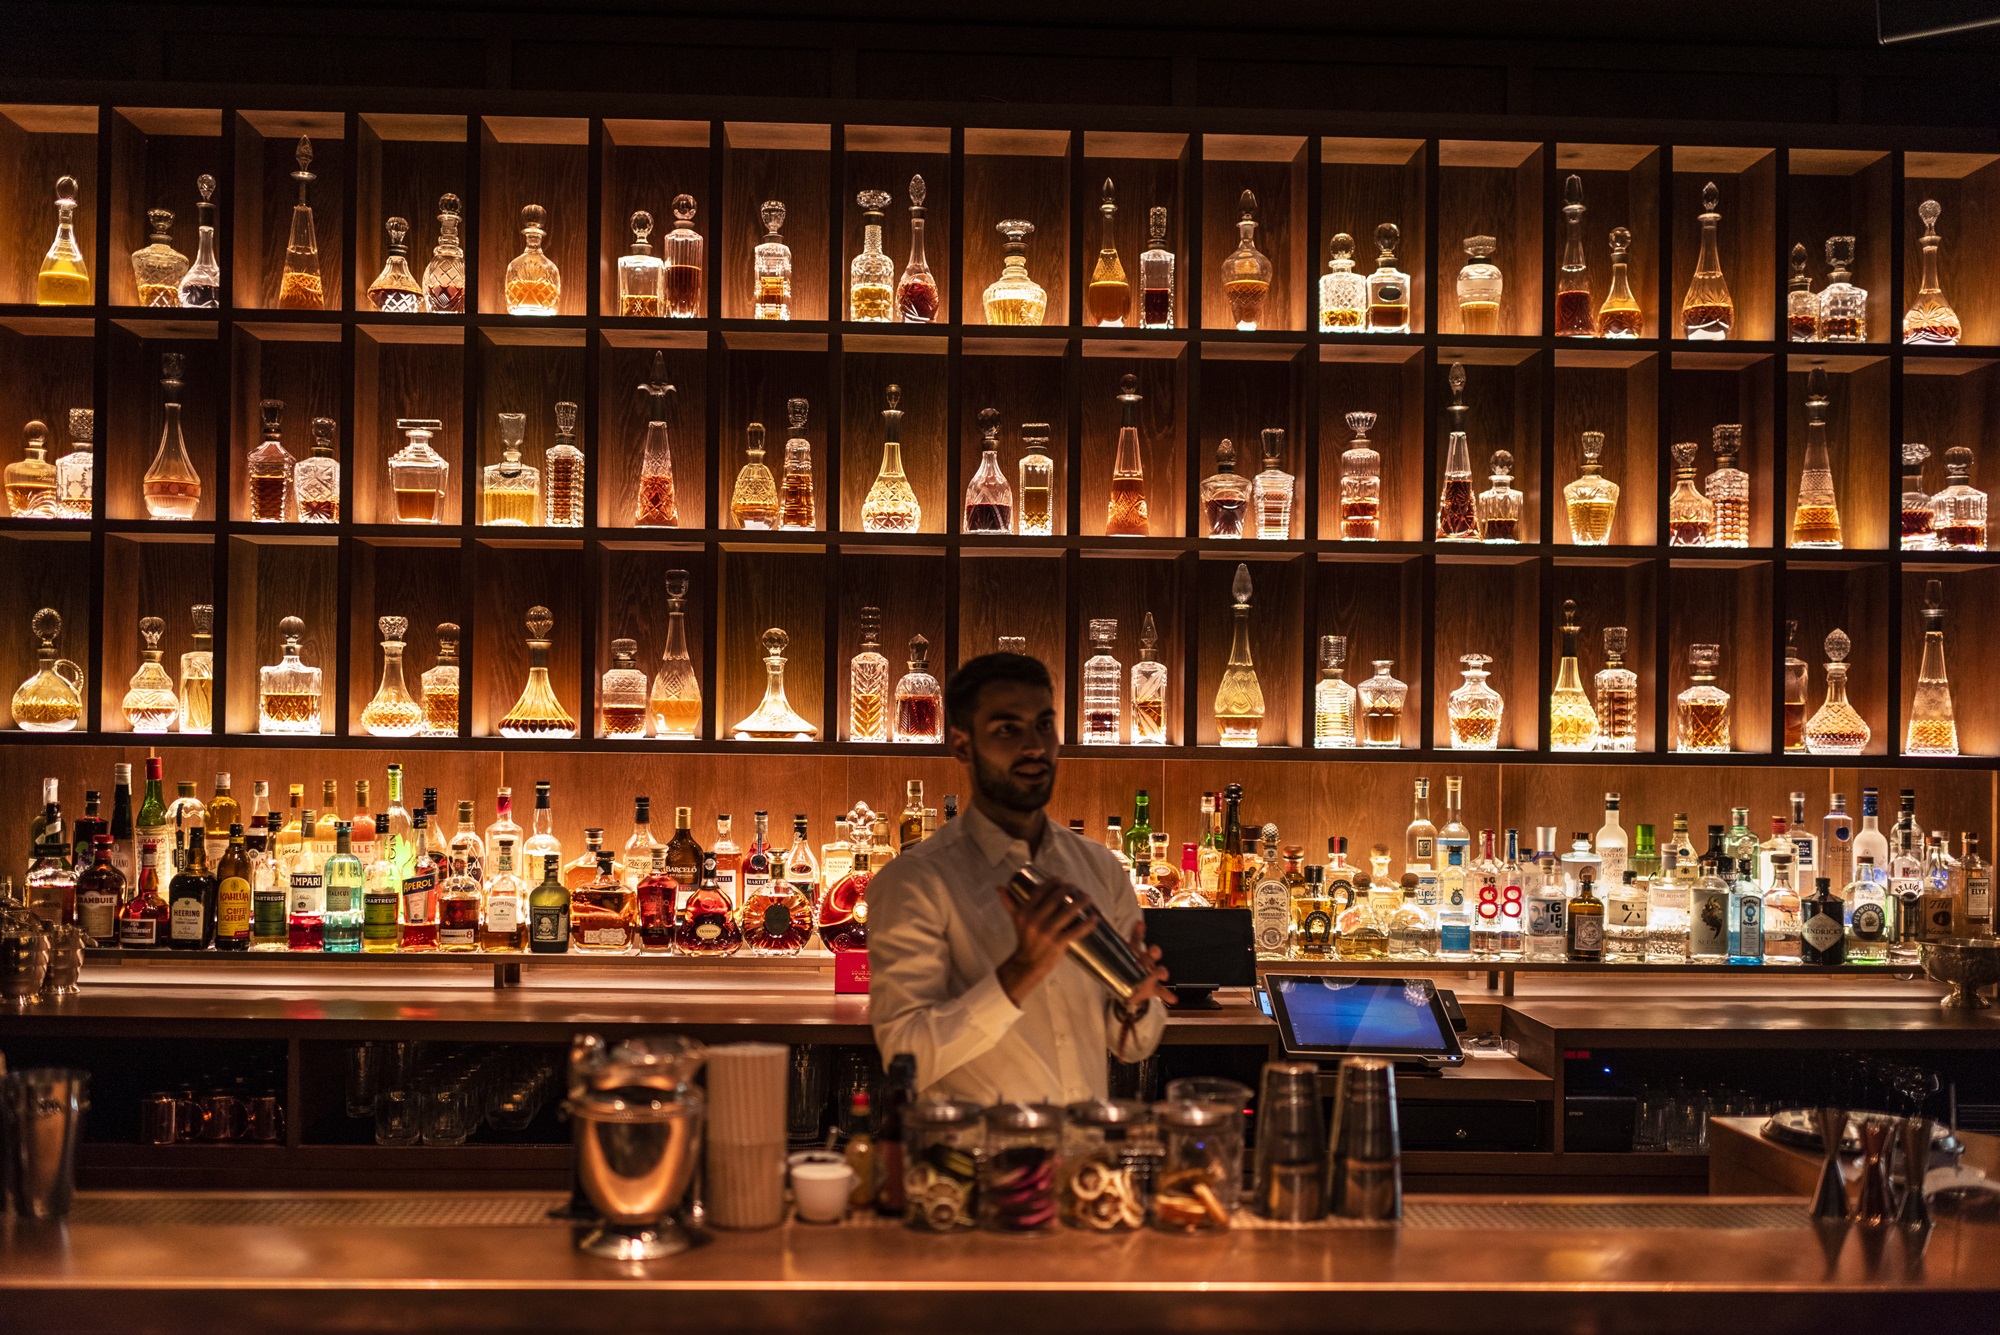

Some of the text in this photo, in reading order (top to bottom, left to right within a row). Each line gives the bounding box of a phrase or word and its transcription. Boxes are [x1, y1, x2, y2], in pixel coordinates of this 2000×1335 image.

[315, 844, 337, 853] ILLE
[351, 844, 374, 853] LLE
[290, 876, 321, 887] AMPARI
[404, 880, 433, 893] APEROL
[219, 889, 249, 902] KAHLÚA
[1546, 902, 1562, 913] 16
[1929, 899, 1951, 910] Tito
[173, 909, 200, 918] HEERING
[227, 907, 248, 916] COFFEE
[1853, 904, 1881, 924] PLYMOUTH
[220, 914, 246, 922] LIQUEUR
[1550, 914, 1563, 929] 15
[466, 930, 473, 939] 8
